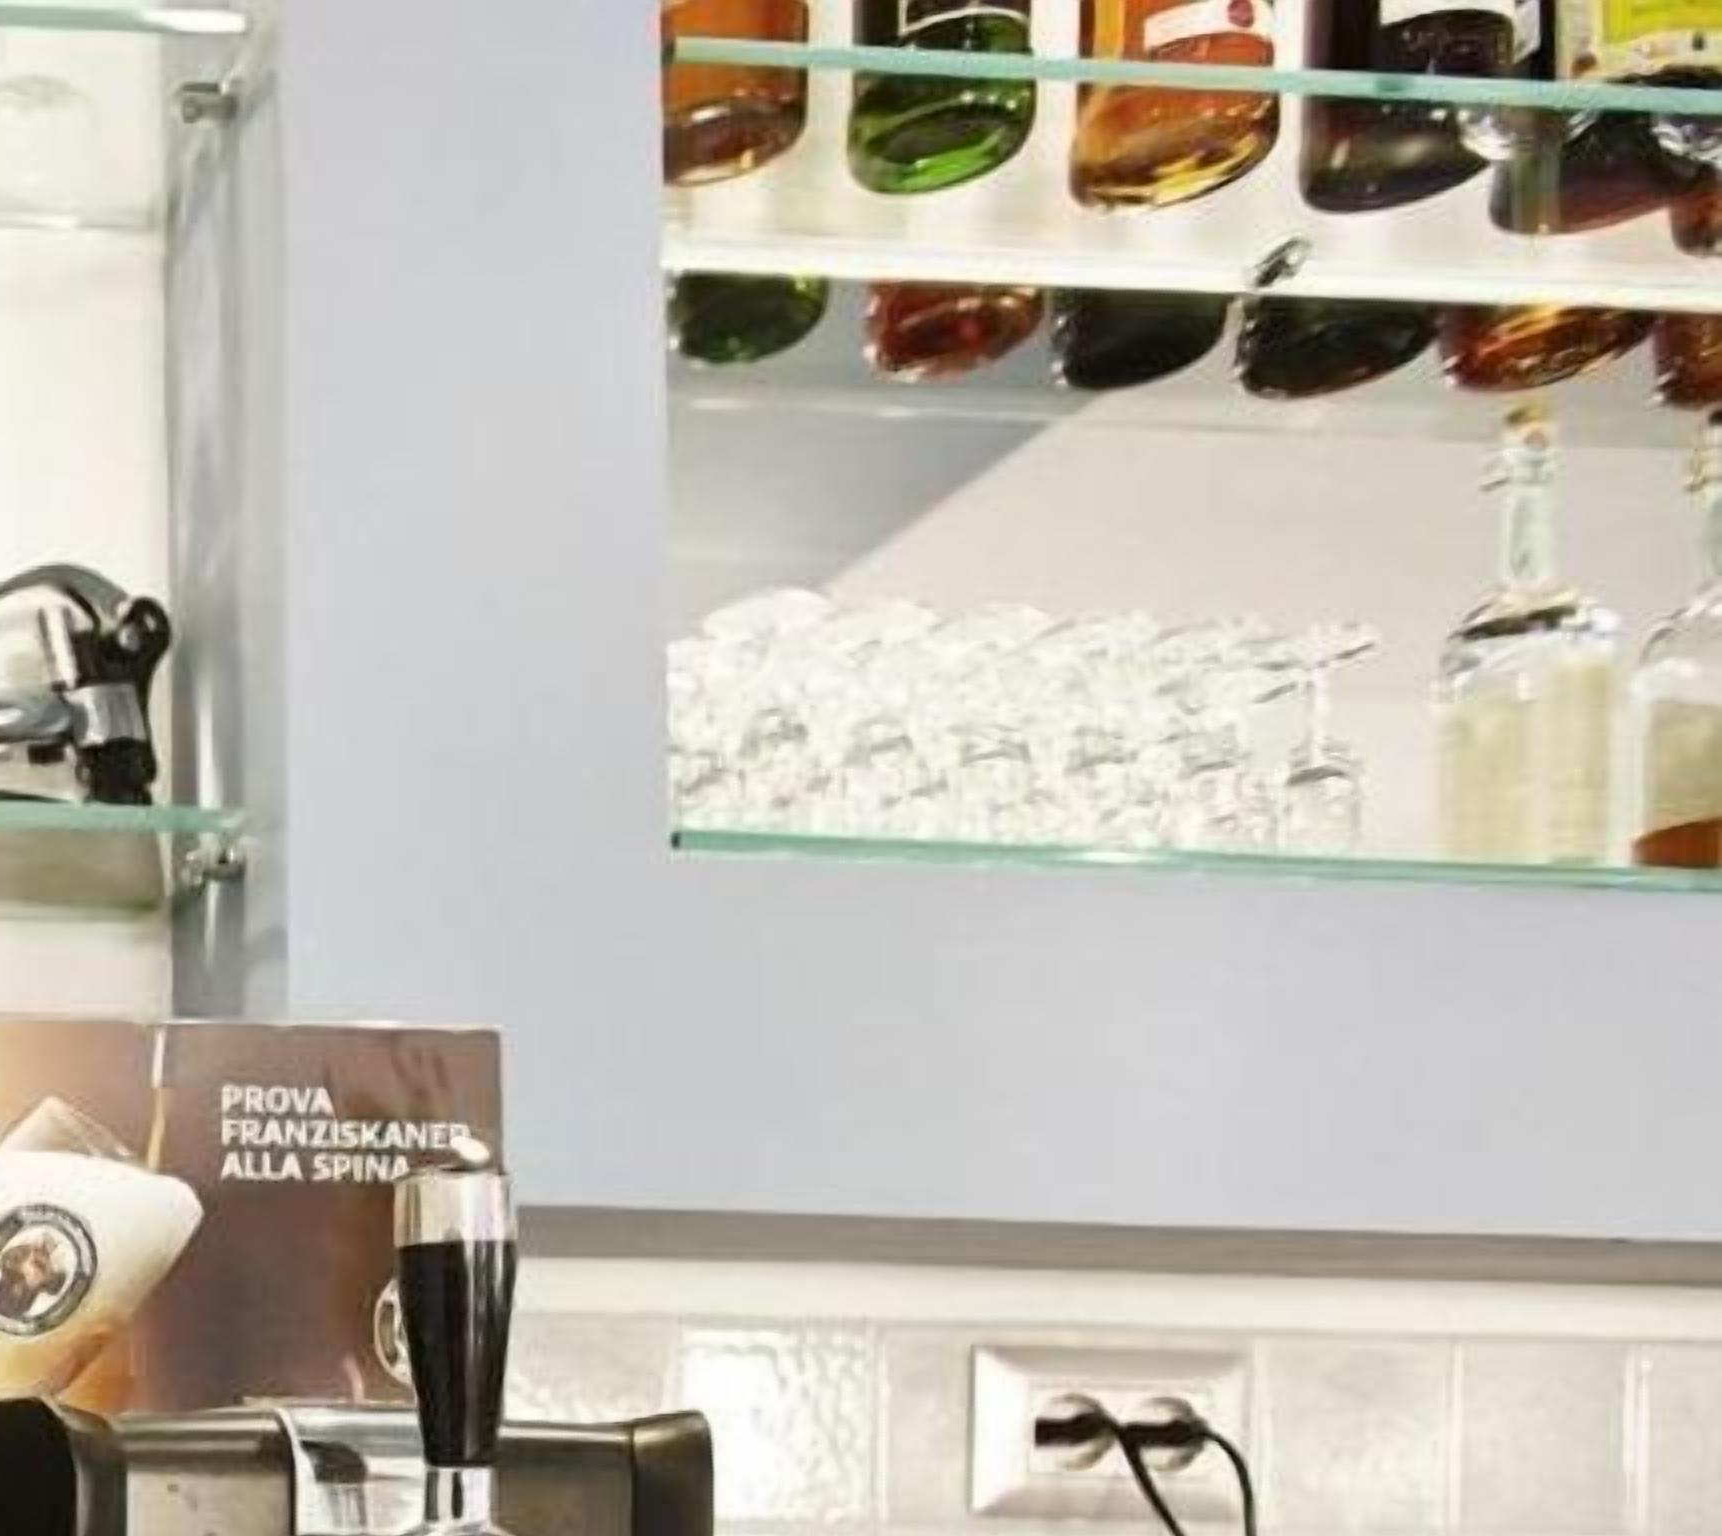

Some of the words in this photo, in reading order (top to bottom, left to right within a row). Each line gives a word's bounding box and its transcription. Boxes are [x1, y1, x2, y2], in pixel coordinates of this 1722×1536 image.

[221, 1084, 335, 1115] PROVA
[220, 1151, 303, 1181] ALLA
[313, 1153, 410, 1183] SPINA
